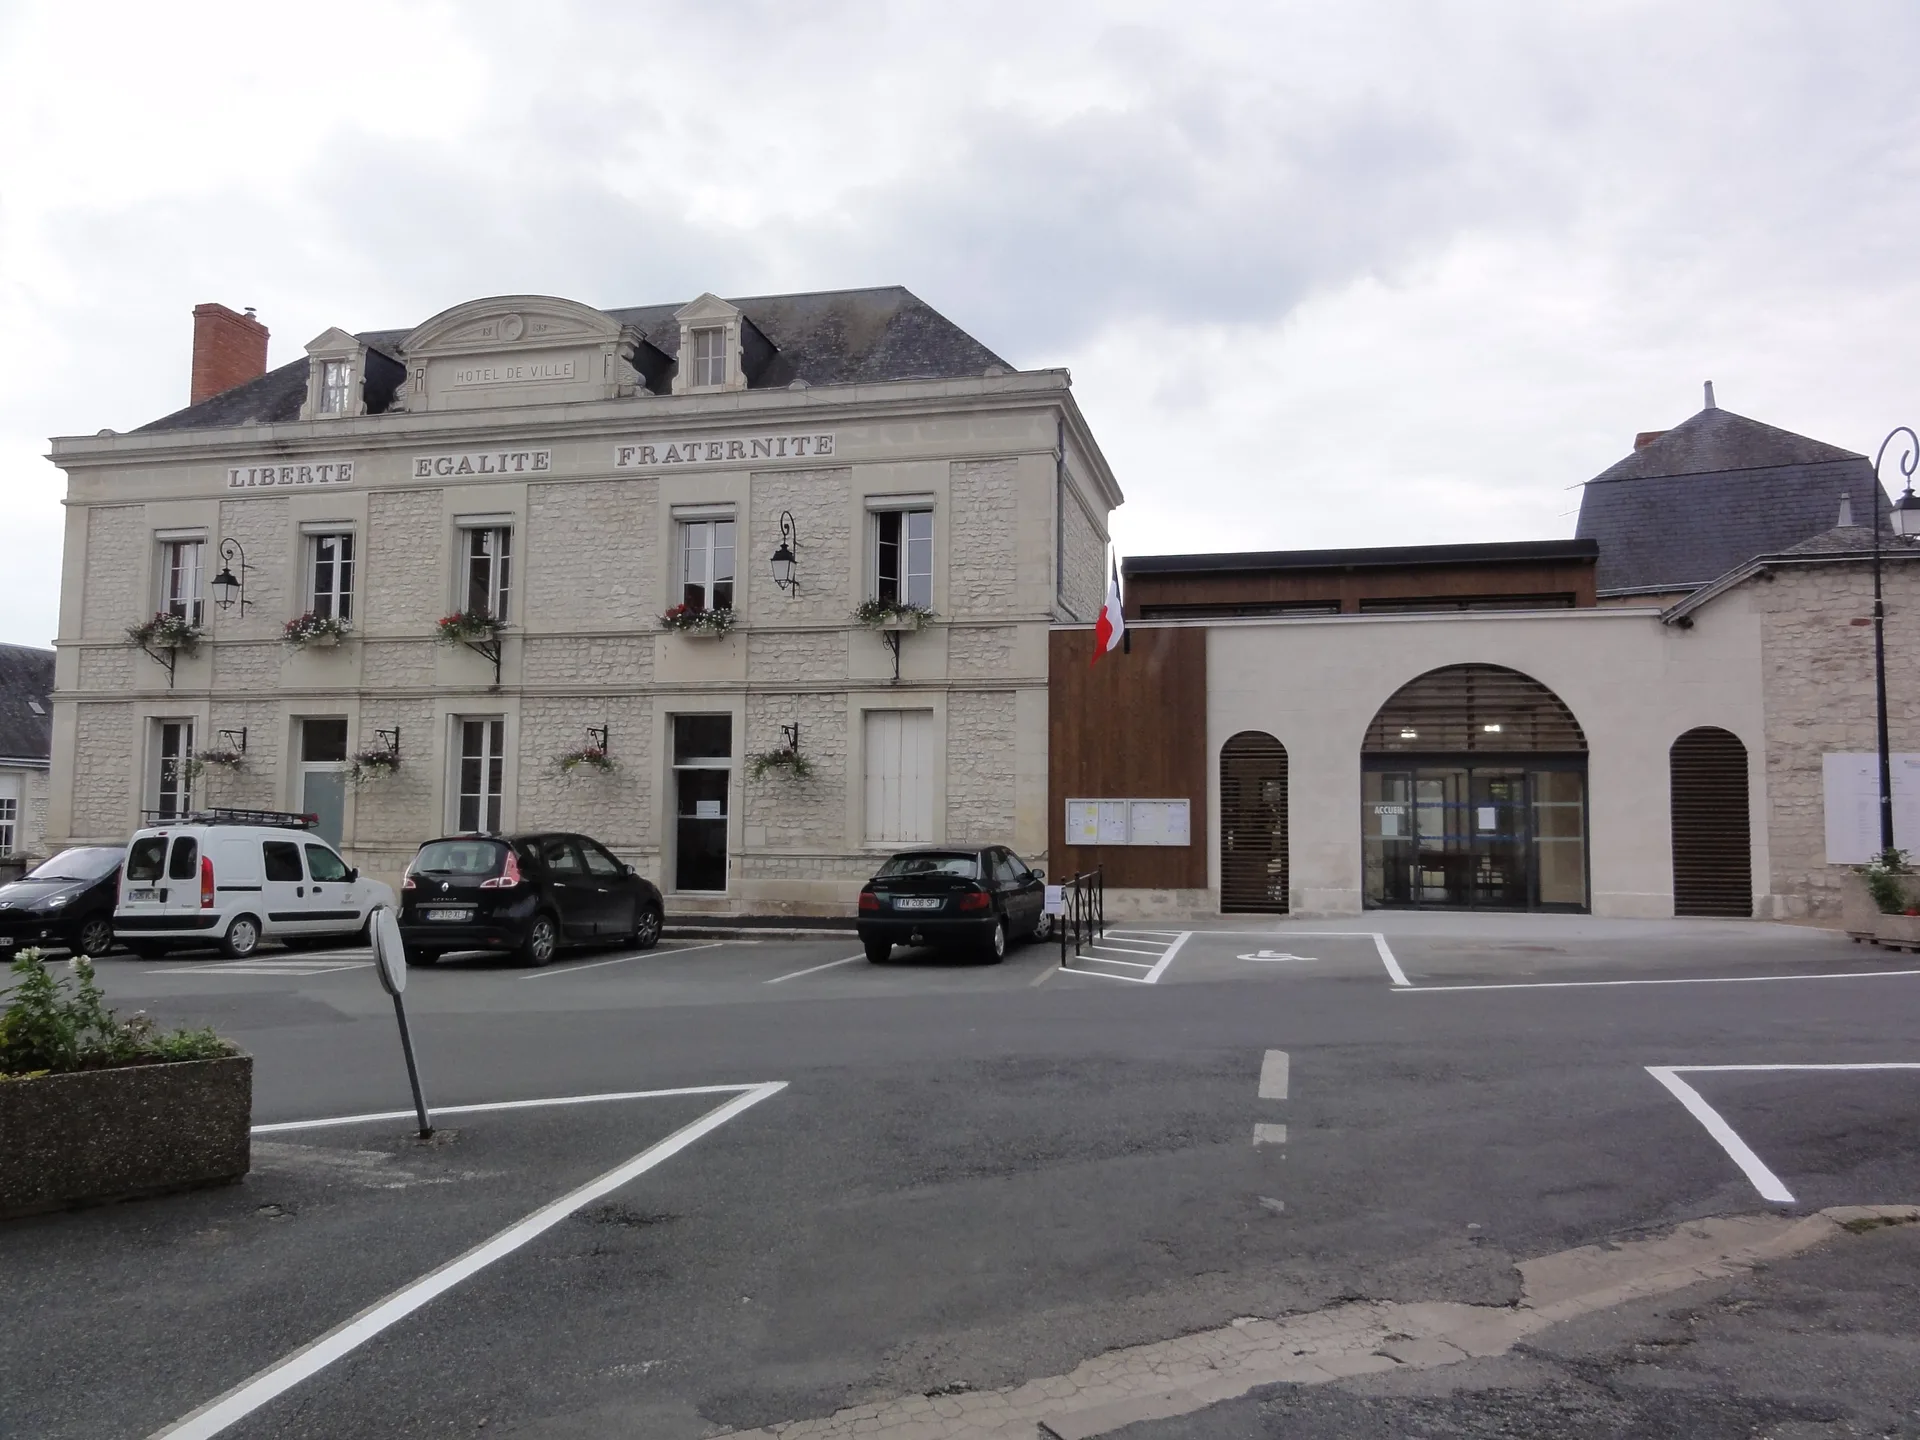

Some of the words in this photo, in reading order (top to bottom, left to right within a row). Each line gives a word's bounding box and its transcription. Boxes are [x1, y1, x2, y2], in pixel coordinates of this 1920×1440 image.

[456, 368, 500, 382] HOTEL
[506, 367, 523, 378] DE
[530, 364, 571, 377] VILLE
[229, 463, 353, 488] LIBERTE
[414, 451, 549, 477] EGALITE
[617, 435, 834, 466] FRATERNITE
[1374, 806, 1405, 815] ACCUEIL
